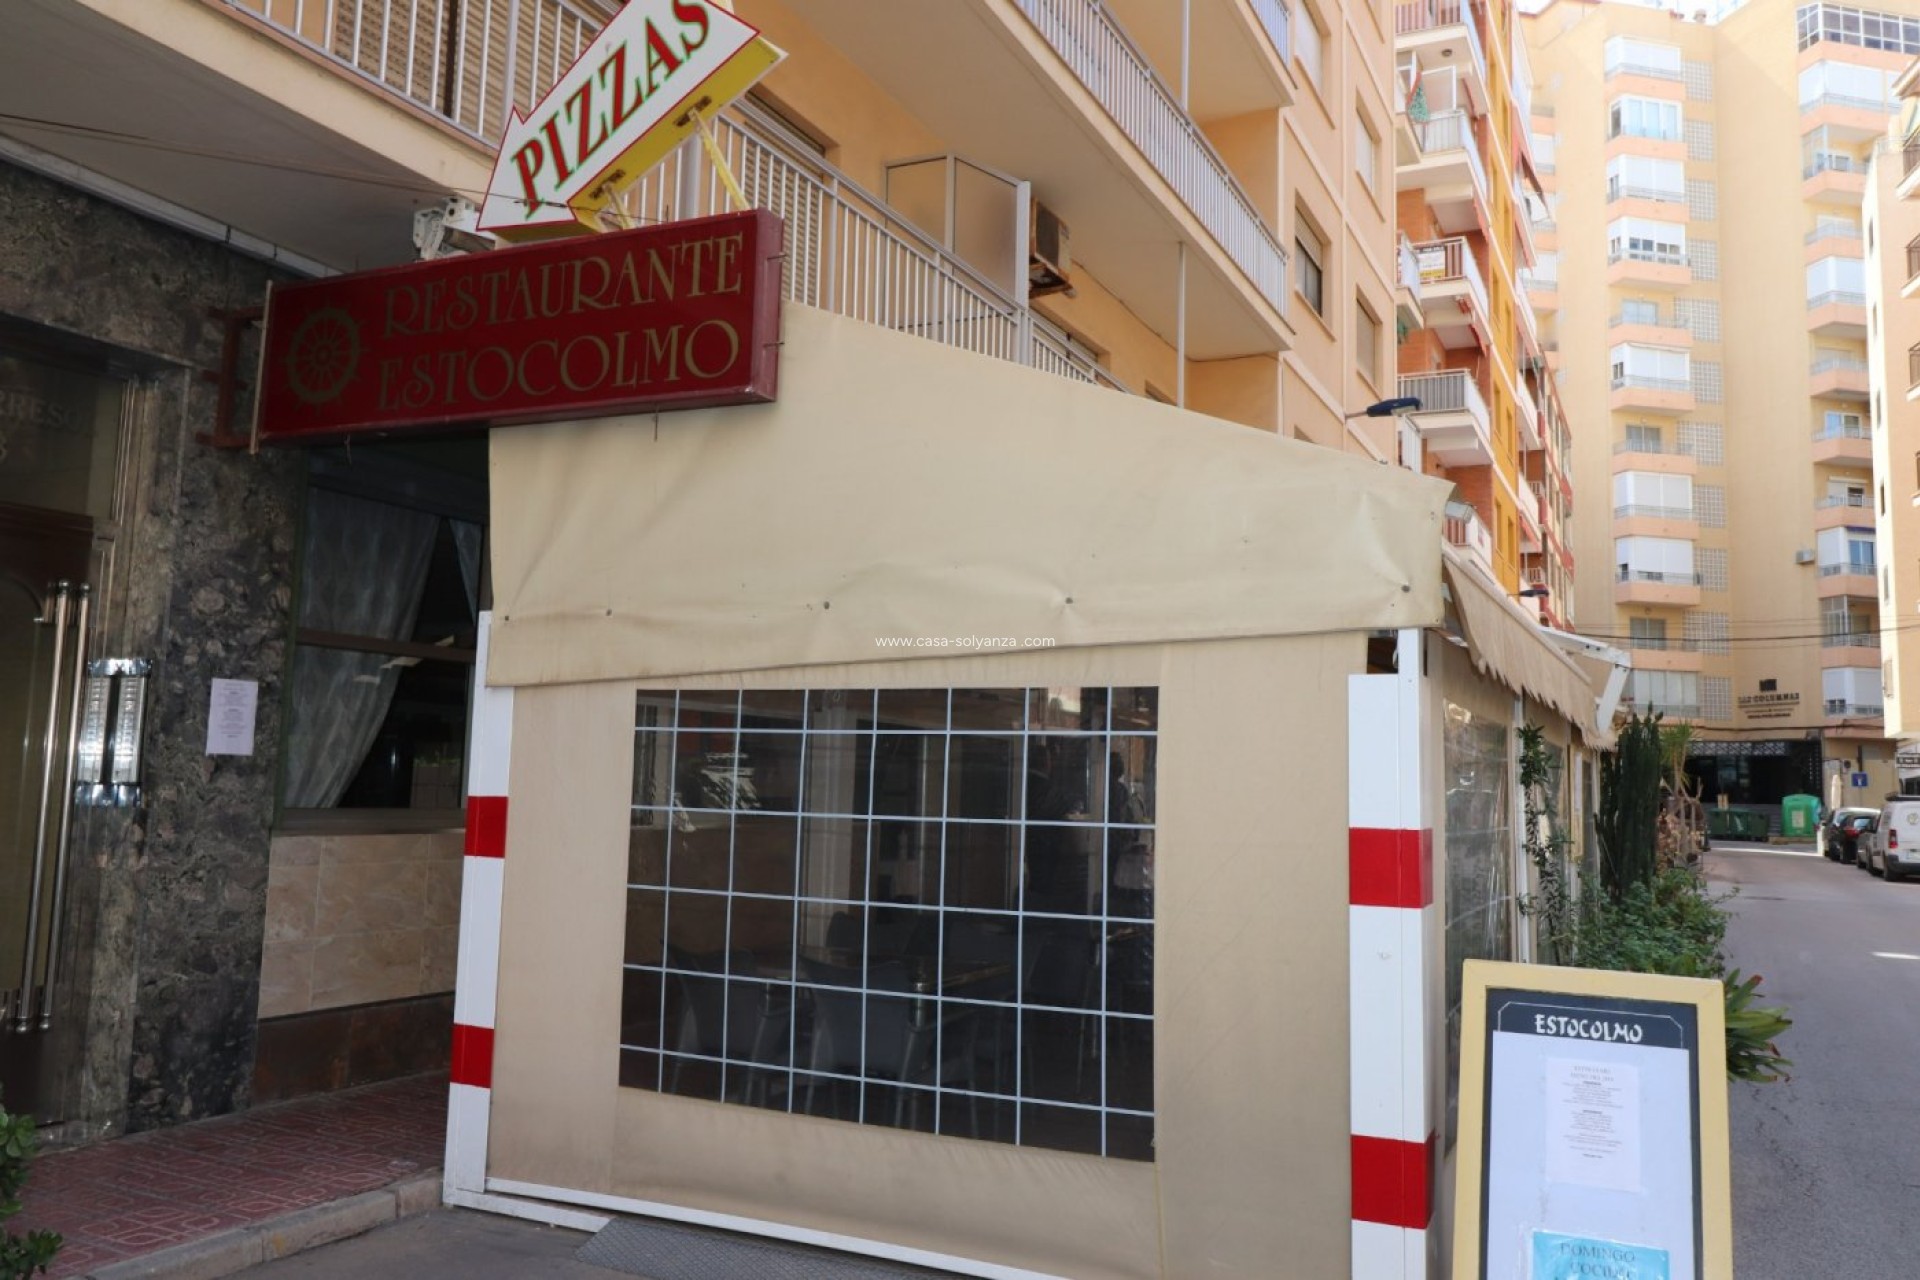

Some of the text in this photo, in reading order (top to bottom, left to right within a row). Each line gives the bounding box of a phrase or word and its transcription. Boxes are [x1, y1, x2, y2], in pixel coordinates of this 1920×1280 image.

[510, 0, 710, 220] PIZZAS
[383, 231, 744, 340] RESTAURANTE
[377, 319, 741, 413] ESTOCOLMO
[1534, 1013, 1644, 1044] ESTOCOLMO
[1559, 1242, 1636, 1263] DOMINGO
